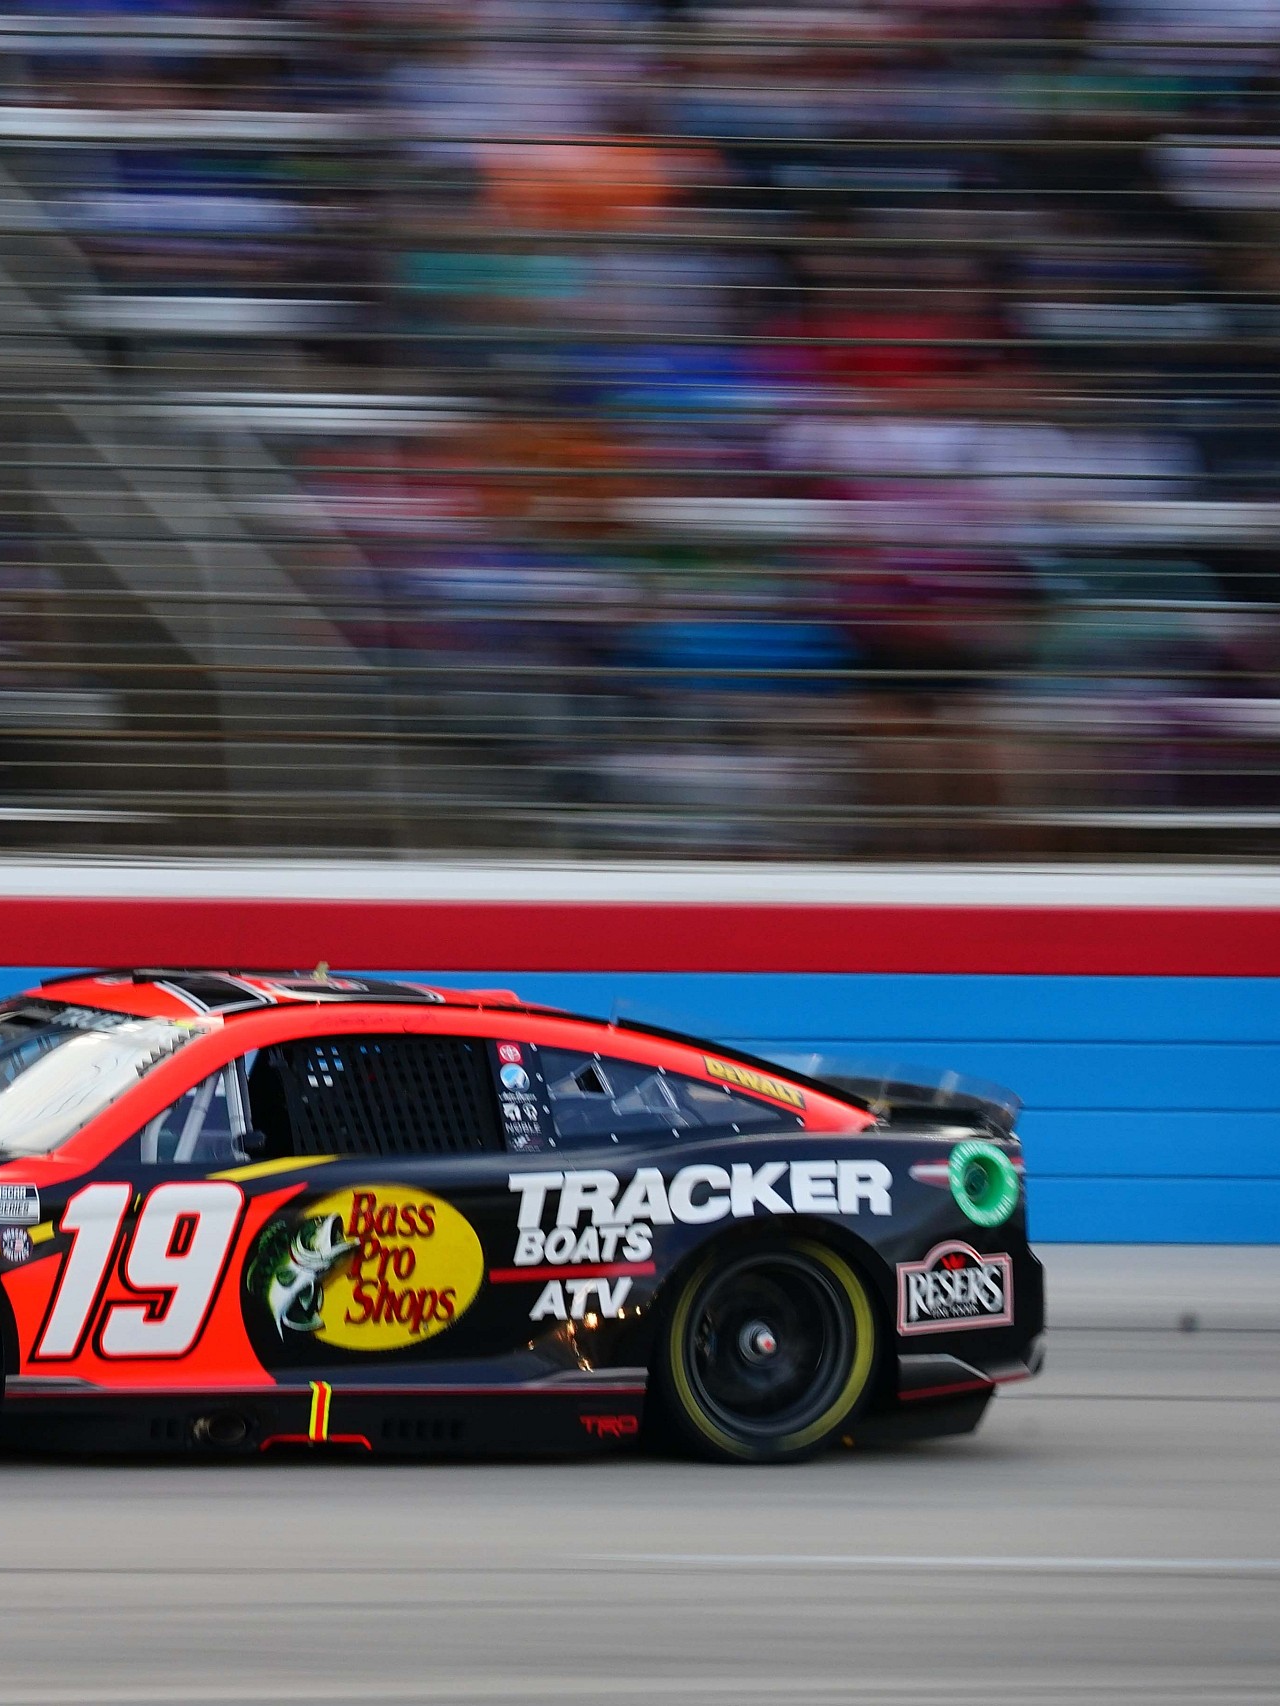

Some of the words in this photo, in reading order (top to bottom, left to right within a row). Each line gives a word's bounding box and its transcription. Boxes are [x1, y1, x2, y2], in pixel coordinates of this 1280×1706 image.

[0, 1202, 29, 1216] SERIES
[348, 1191, 436, 1237] Bass
[508, 1159, 893, 1230] TRACKER
[347, 1235, 416, 1280] Pro
[513, 1223, 653, 1266] BOATS
[38, 1181, 245, 1359] 19
[344, 1279, 456, 1334] Shops
[529, 1277, 634, 1321] ATV
[579, 1414, 639, 1438] TRD
